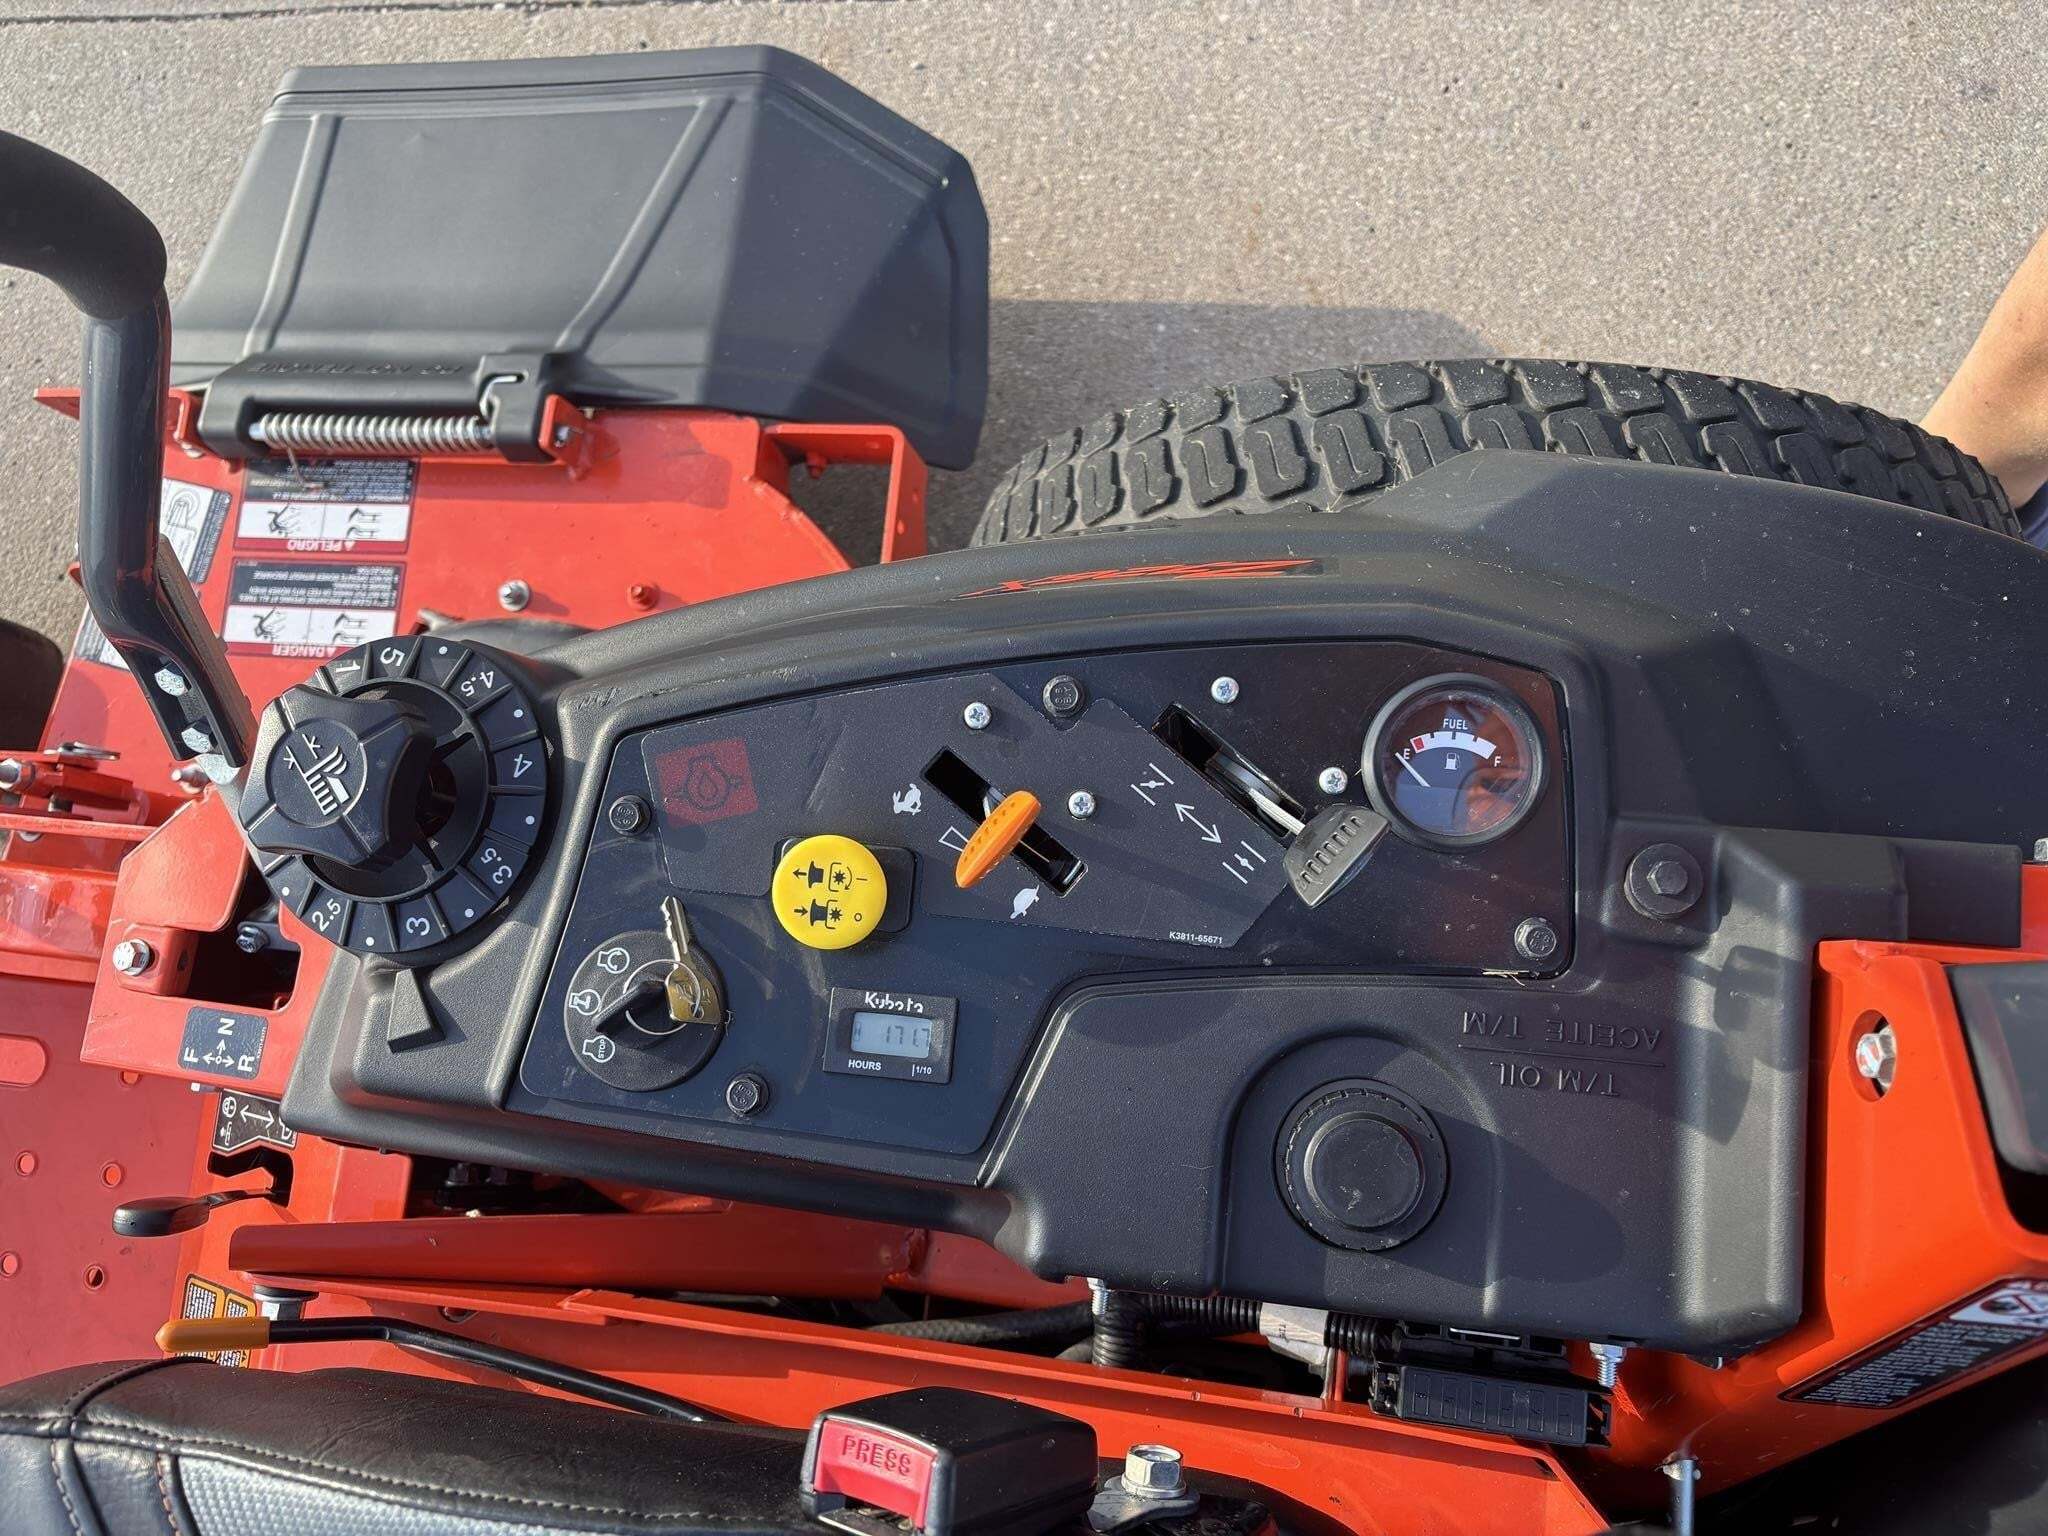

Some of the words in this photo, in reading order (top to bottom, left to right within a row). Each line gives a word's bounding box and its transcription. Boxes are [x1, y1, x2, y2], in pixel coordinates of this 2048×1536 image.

[287, 539, 343, 552] PELIGRO
[272, 644, 327, 657] DANGER
[379, 645, 405, 667] 5
[460, 669, 495, 697] 4.5
[1443, 718, 1468, 730] FUEL
[1403, 748, 1411, 760] E
[1494, 756, 1501, 767] F
[513, 753, 533, 779] 4
[480, 847, 513, 885] 3.5
[311, 898, 342, 932] 2.5
[405, 916, 431, 936] 3
[1169, 931, 1223, 944] K3811-65671
[865, 991, 924, 1014] Kubota
[217, 1017, 236, 1036] N
[1462, 1011, 1525, 1040] T/M
[1545, 1018, 1661, 1050] ACEITE
[183, 1047, 199, 1063] F
[598, 1039, 606, 1059] STOP
[237, 1054, 256, 1072] R
[848, 1059, 882, 1071] HOURS
[916, 1066, 932, 1075] 1/10
[1490, 1061, 1542, 1088] OIL
[1558, 1069, 1621, 1097] T/M
[842, 1435, 911, 1477] PRESS
